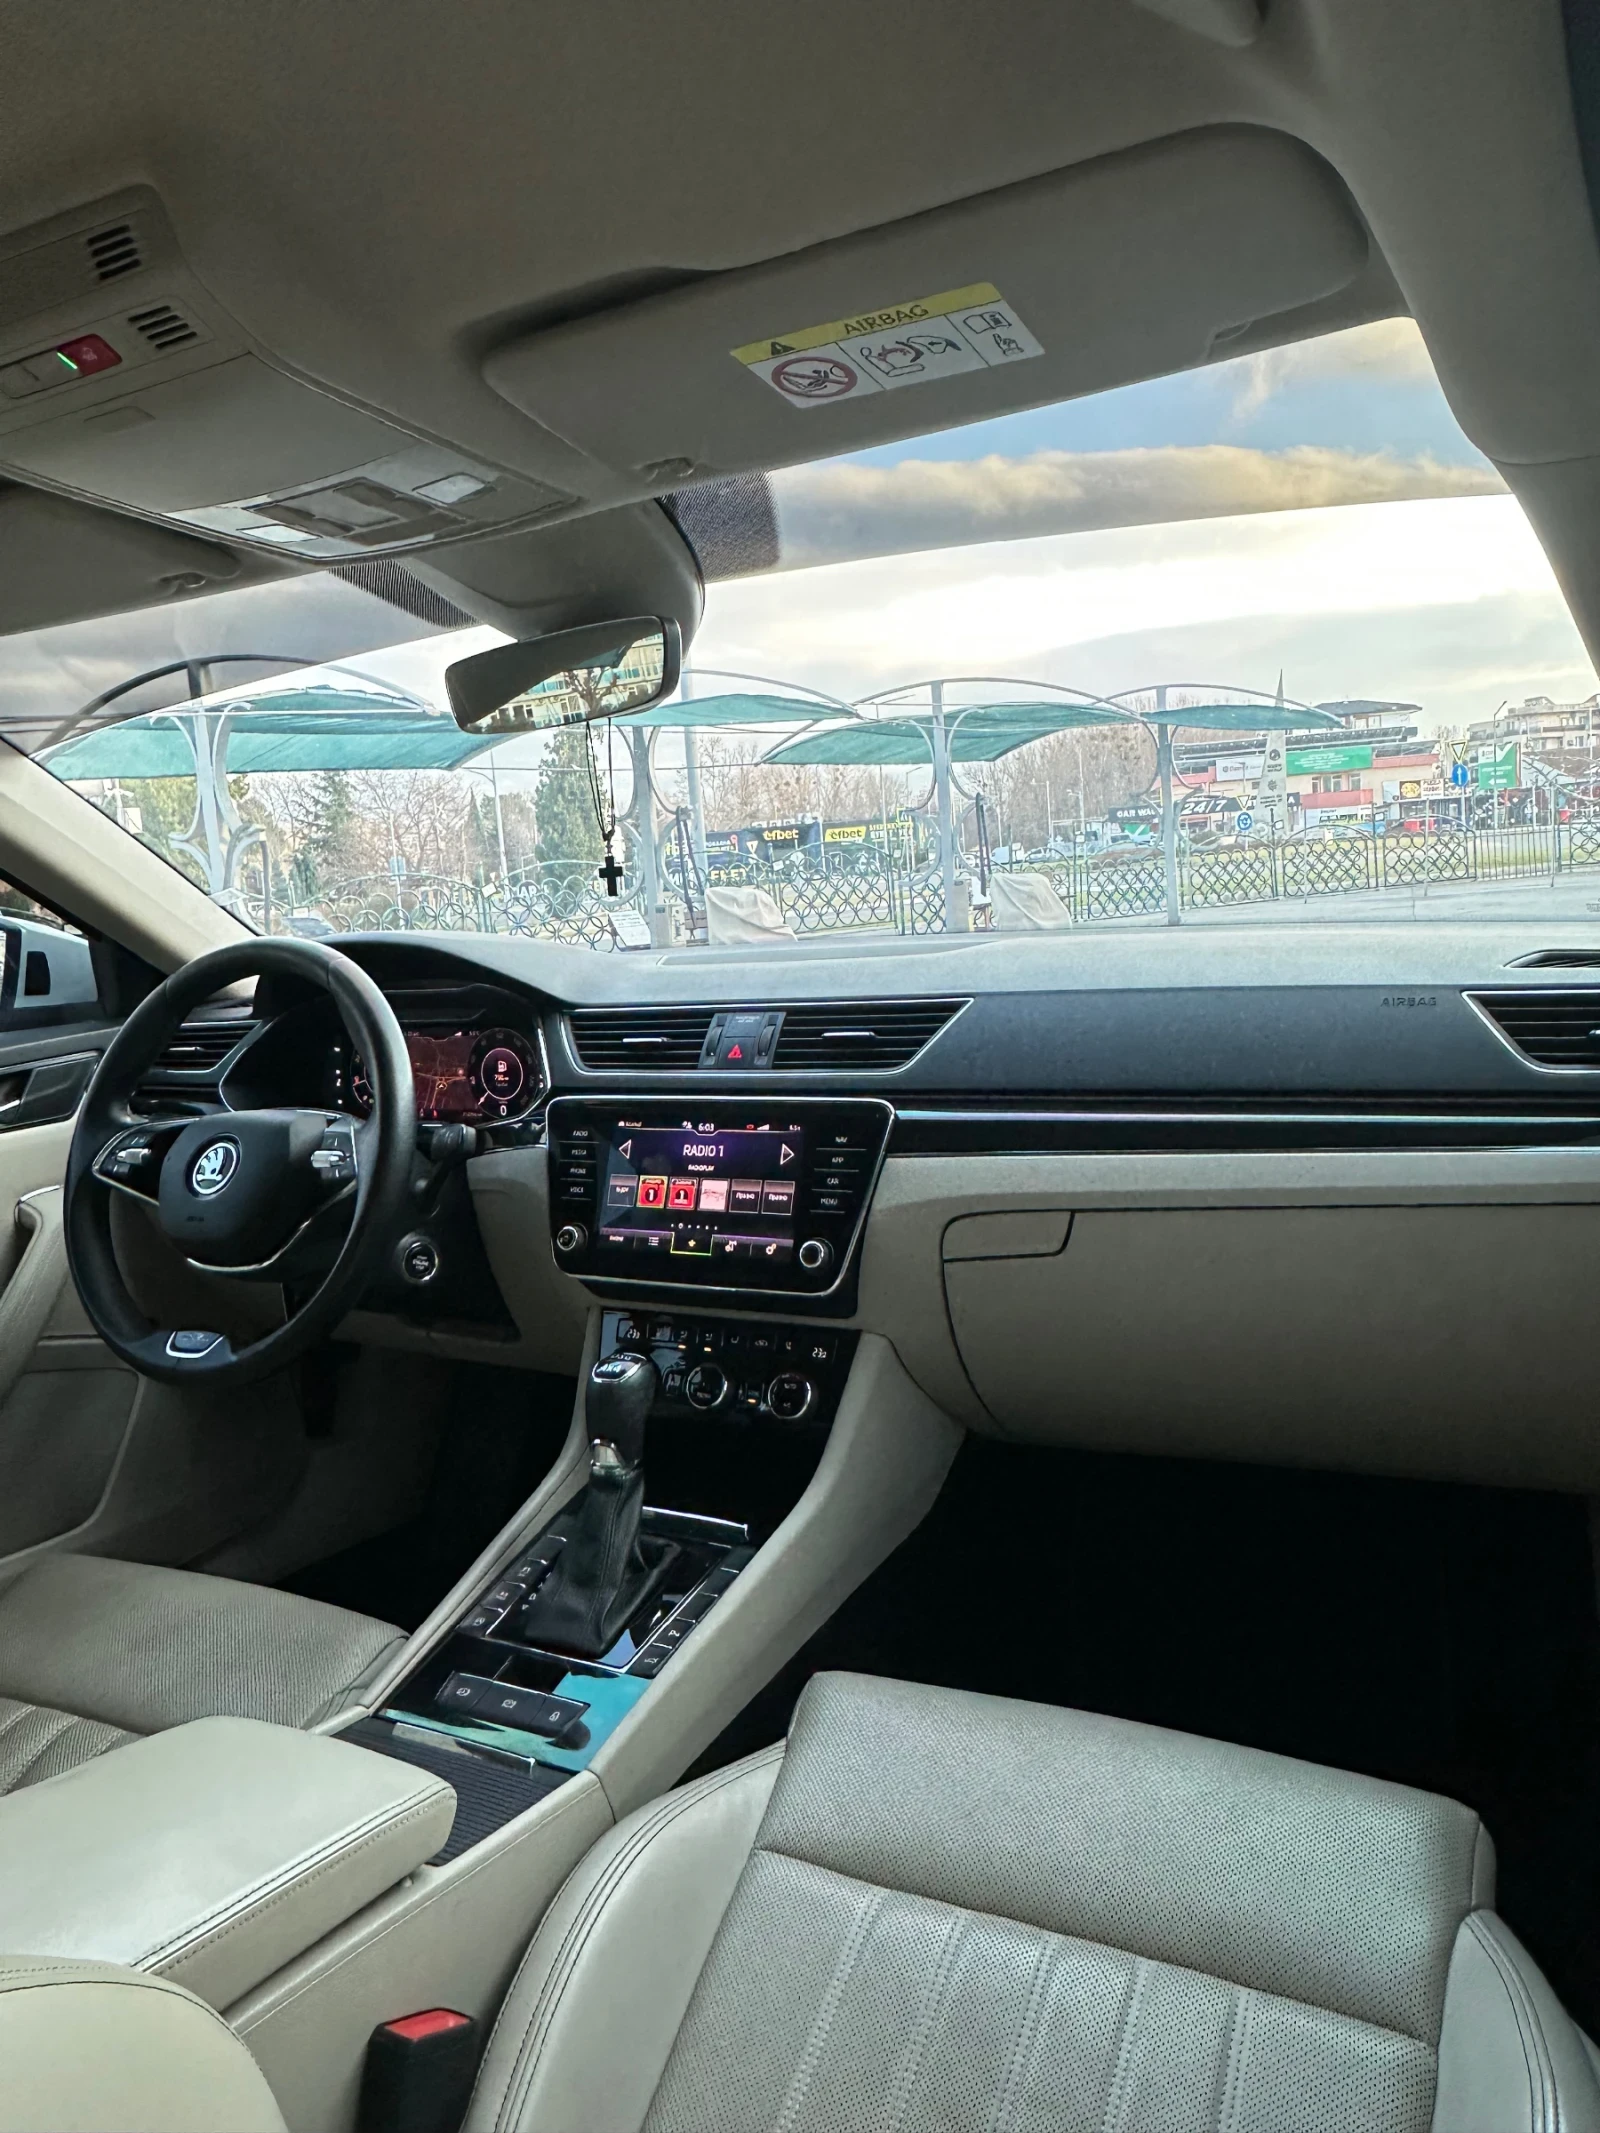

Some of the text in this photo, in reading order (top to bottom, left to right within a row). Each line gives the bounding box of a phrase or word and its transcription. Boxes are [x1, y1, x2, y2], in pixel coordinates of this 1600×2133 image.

[844, 304, 929, 335] AIRBAG
[1181, 800, 1228, 815] 24/7
[763, 829, 799, 841] efbet
[829, 829, 863, 840] efbet
[1380, 997, 1437, 1007] AIRBAG
[499, 1104, 507, 1116] 0
[698, 1122, 715, 1132] 6:03
[682, 1144, 724, 1157] RADIO 1
